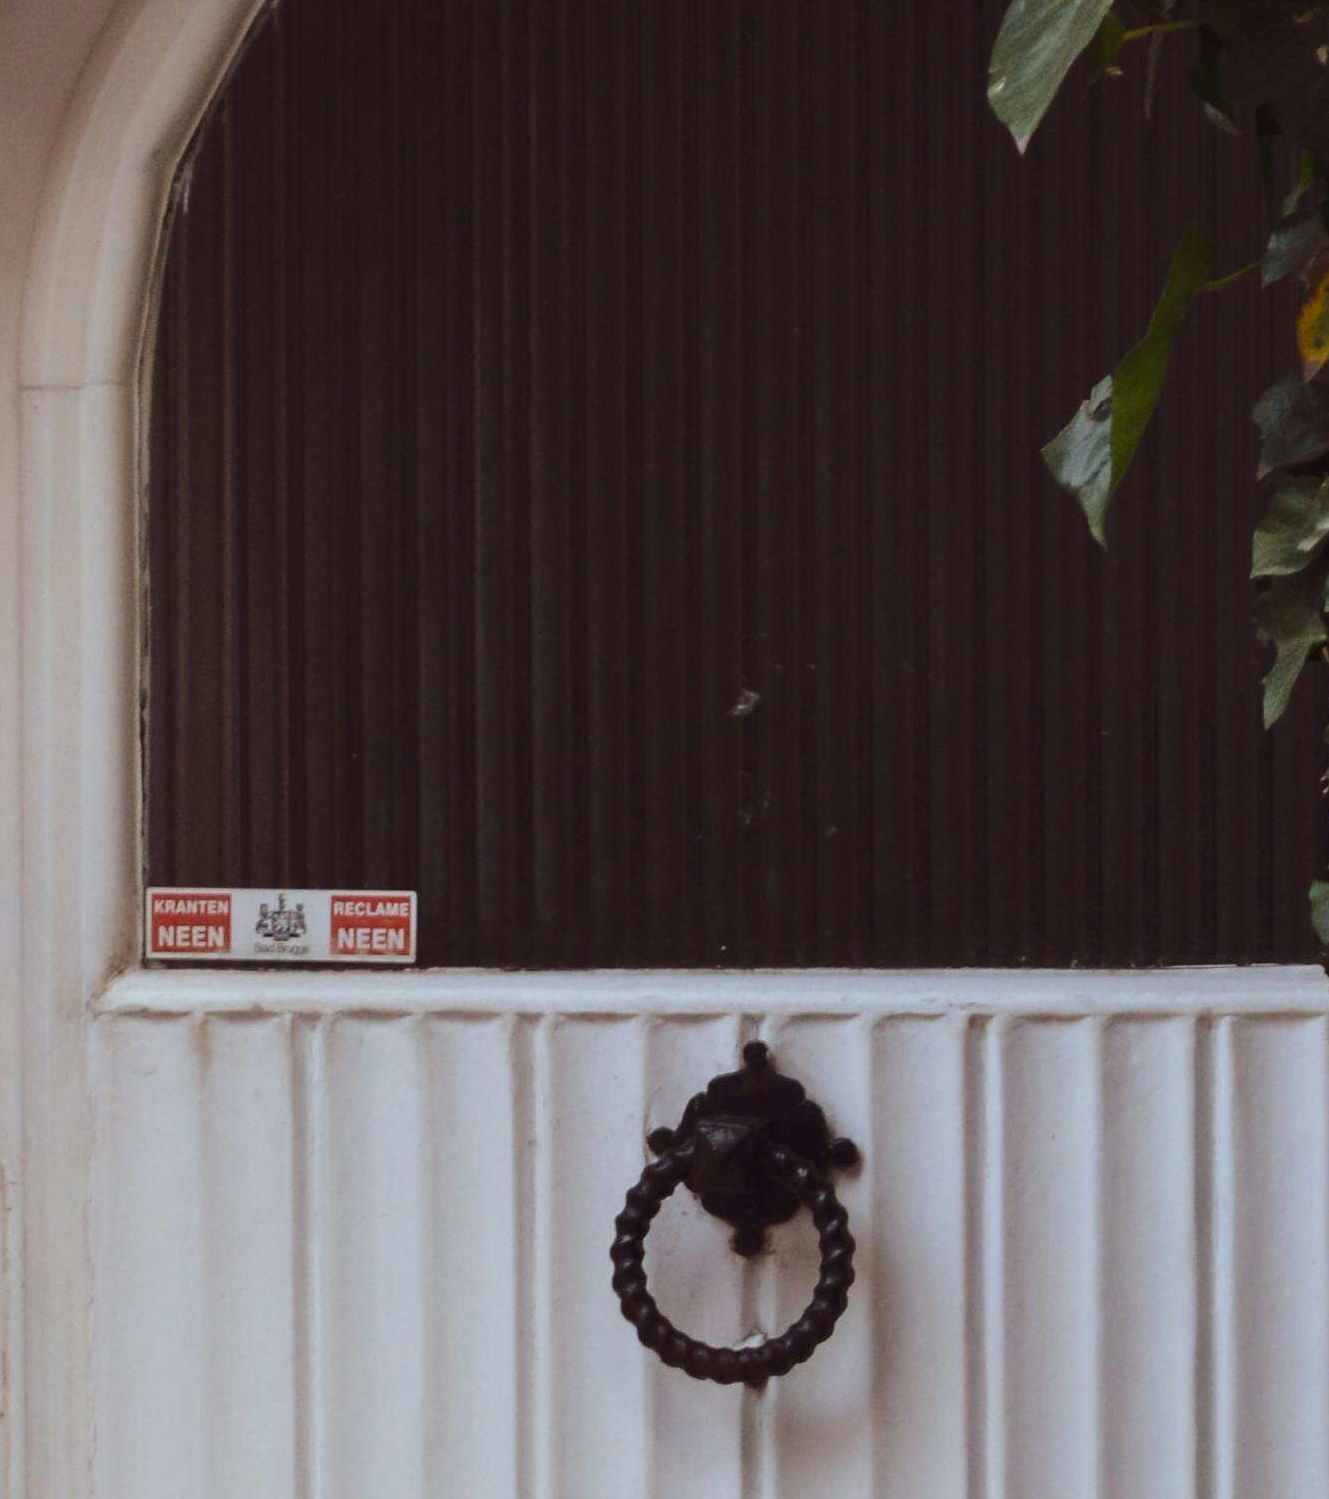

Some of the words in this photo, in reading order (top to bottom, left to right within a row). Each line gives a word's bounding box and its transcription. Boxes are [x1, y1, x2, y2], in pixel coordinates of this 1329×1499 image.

[153, 899, 229, 914] KRANTEN
[333, 902, 410, 916] RECLAME
[158, 926, 225, 947] NEEN
[338, 928, 405, 949] NEEN
